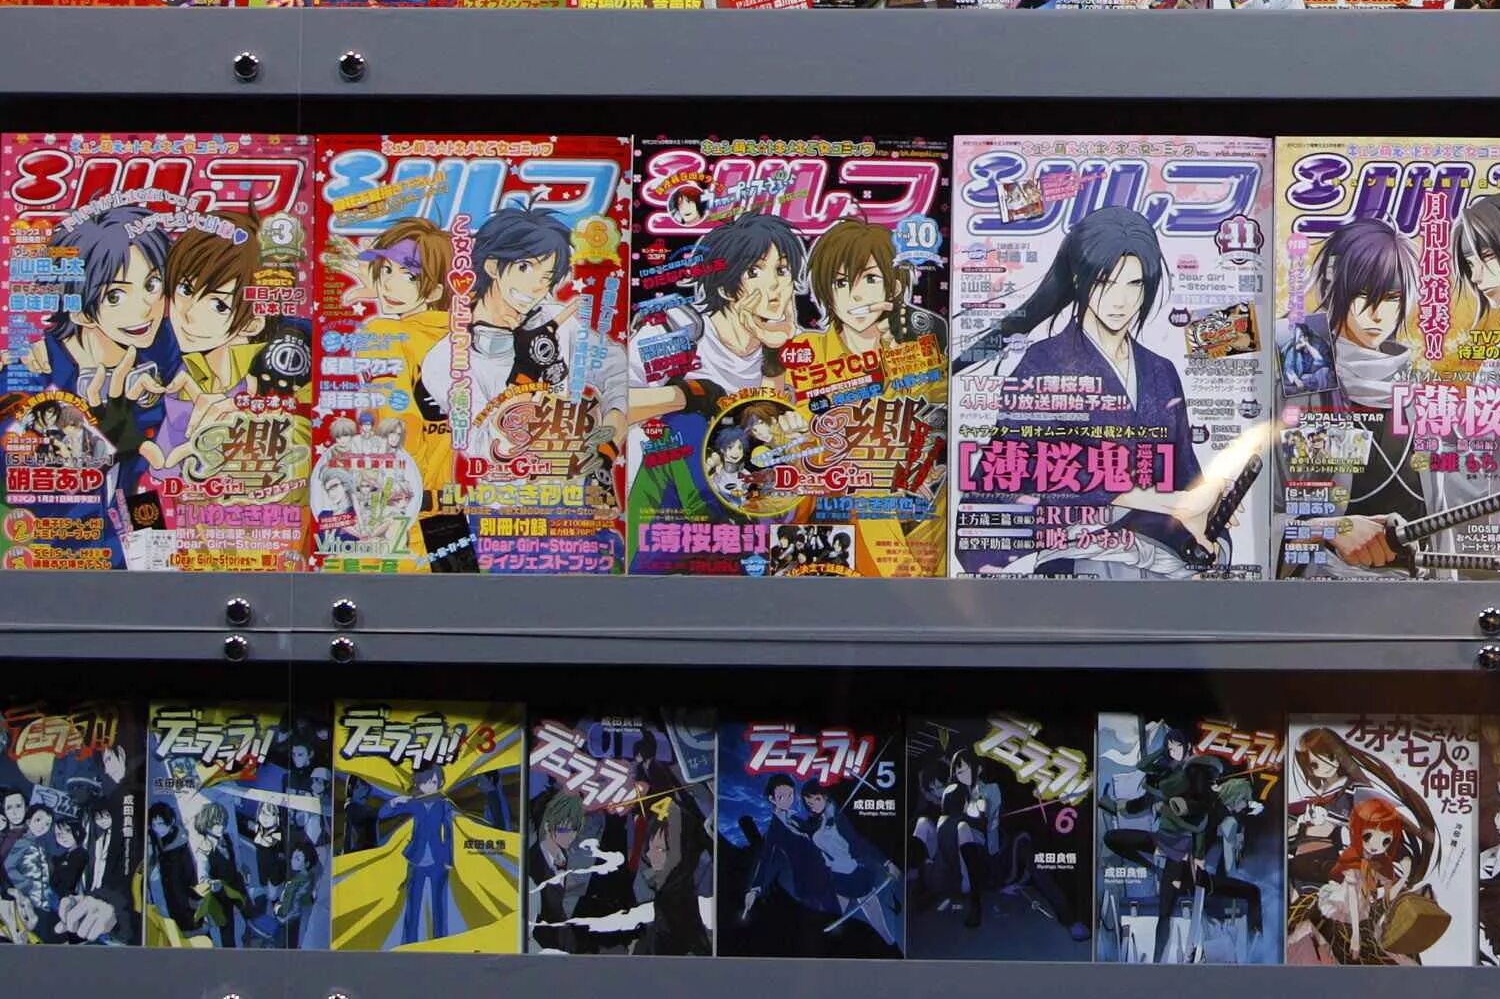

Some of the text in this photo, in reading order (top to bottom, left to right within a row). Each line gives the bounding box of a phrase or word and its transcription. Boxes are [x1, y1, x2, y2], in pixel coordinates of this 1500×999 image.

[1420, 191, 1450, 360] 月刊化発表!!
[781, 349, 811, 363] 付録
[790, 350, 879, 388] ドラマCD
[1047, 506, 1112, 525] RURU
[1077, 529, 1136, 549] かおり
[478, 554, 613, 571] ダイジェストブック
[1402, 741, 1471, 768] 七人の
[875, 761, 896, 789] 5
[1422, 770, 1478, 799] 仲間
[1257, 773, 1276, 801] 7
[853, 798, 896, 812] 成田良悟
[1440, 797, 1474, 815] たち
[1054, 807, 1075, 835] 6
[1034, 852, 1077, 865] 成田良悟
